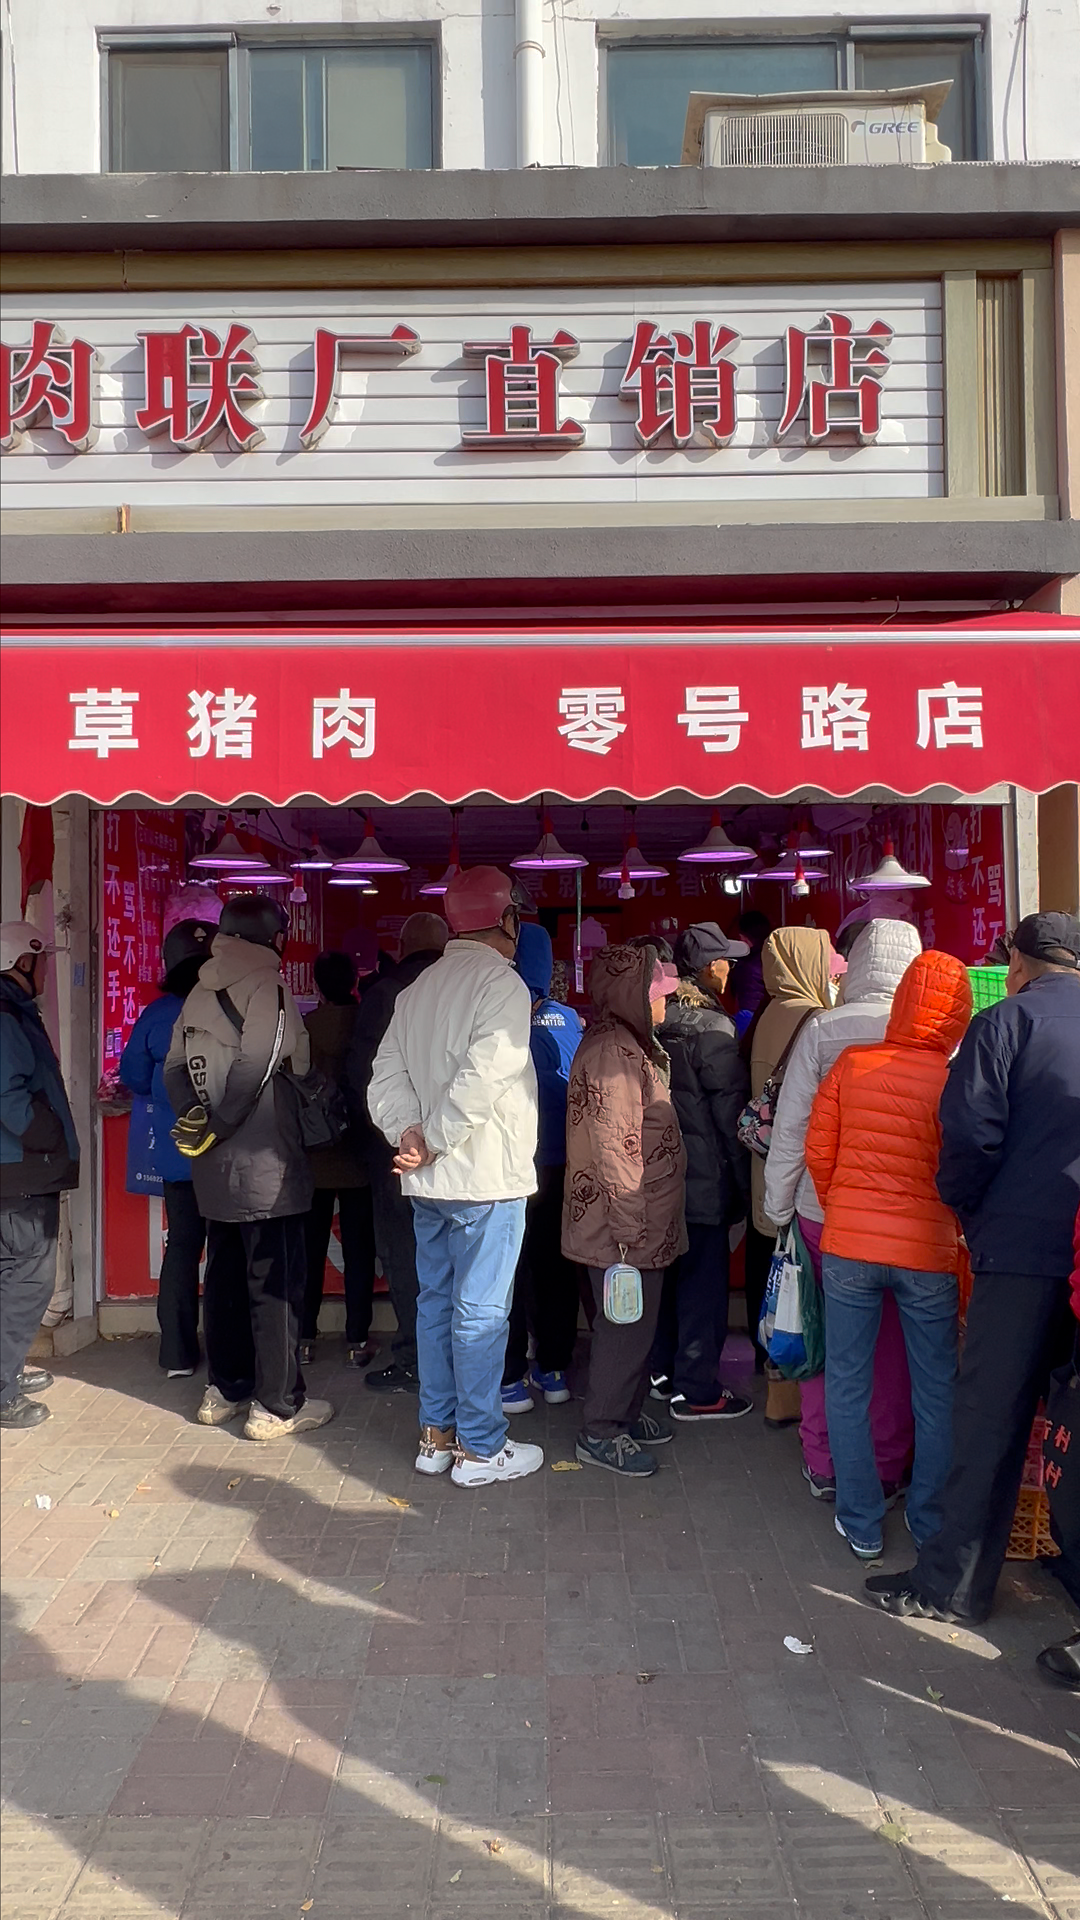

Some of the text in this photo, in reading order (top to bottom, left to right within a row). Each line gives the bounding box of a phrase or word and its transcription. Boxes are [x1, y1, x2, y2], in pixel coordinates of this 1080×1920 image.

[868, 122, 919, 134] GREE
[0, 311, 896, 449] 肉联厂直销店
[68, 681, 984, 759] 草猪肉 零号路店
[105, 810, 121, 1013] 打不还手
[970, 805, 986, 965] 打不还
